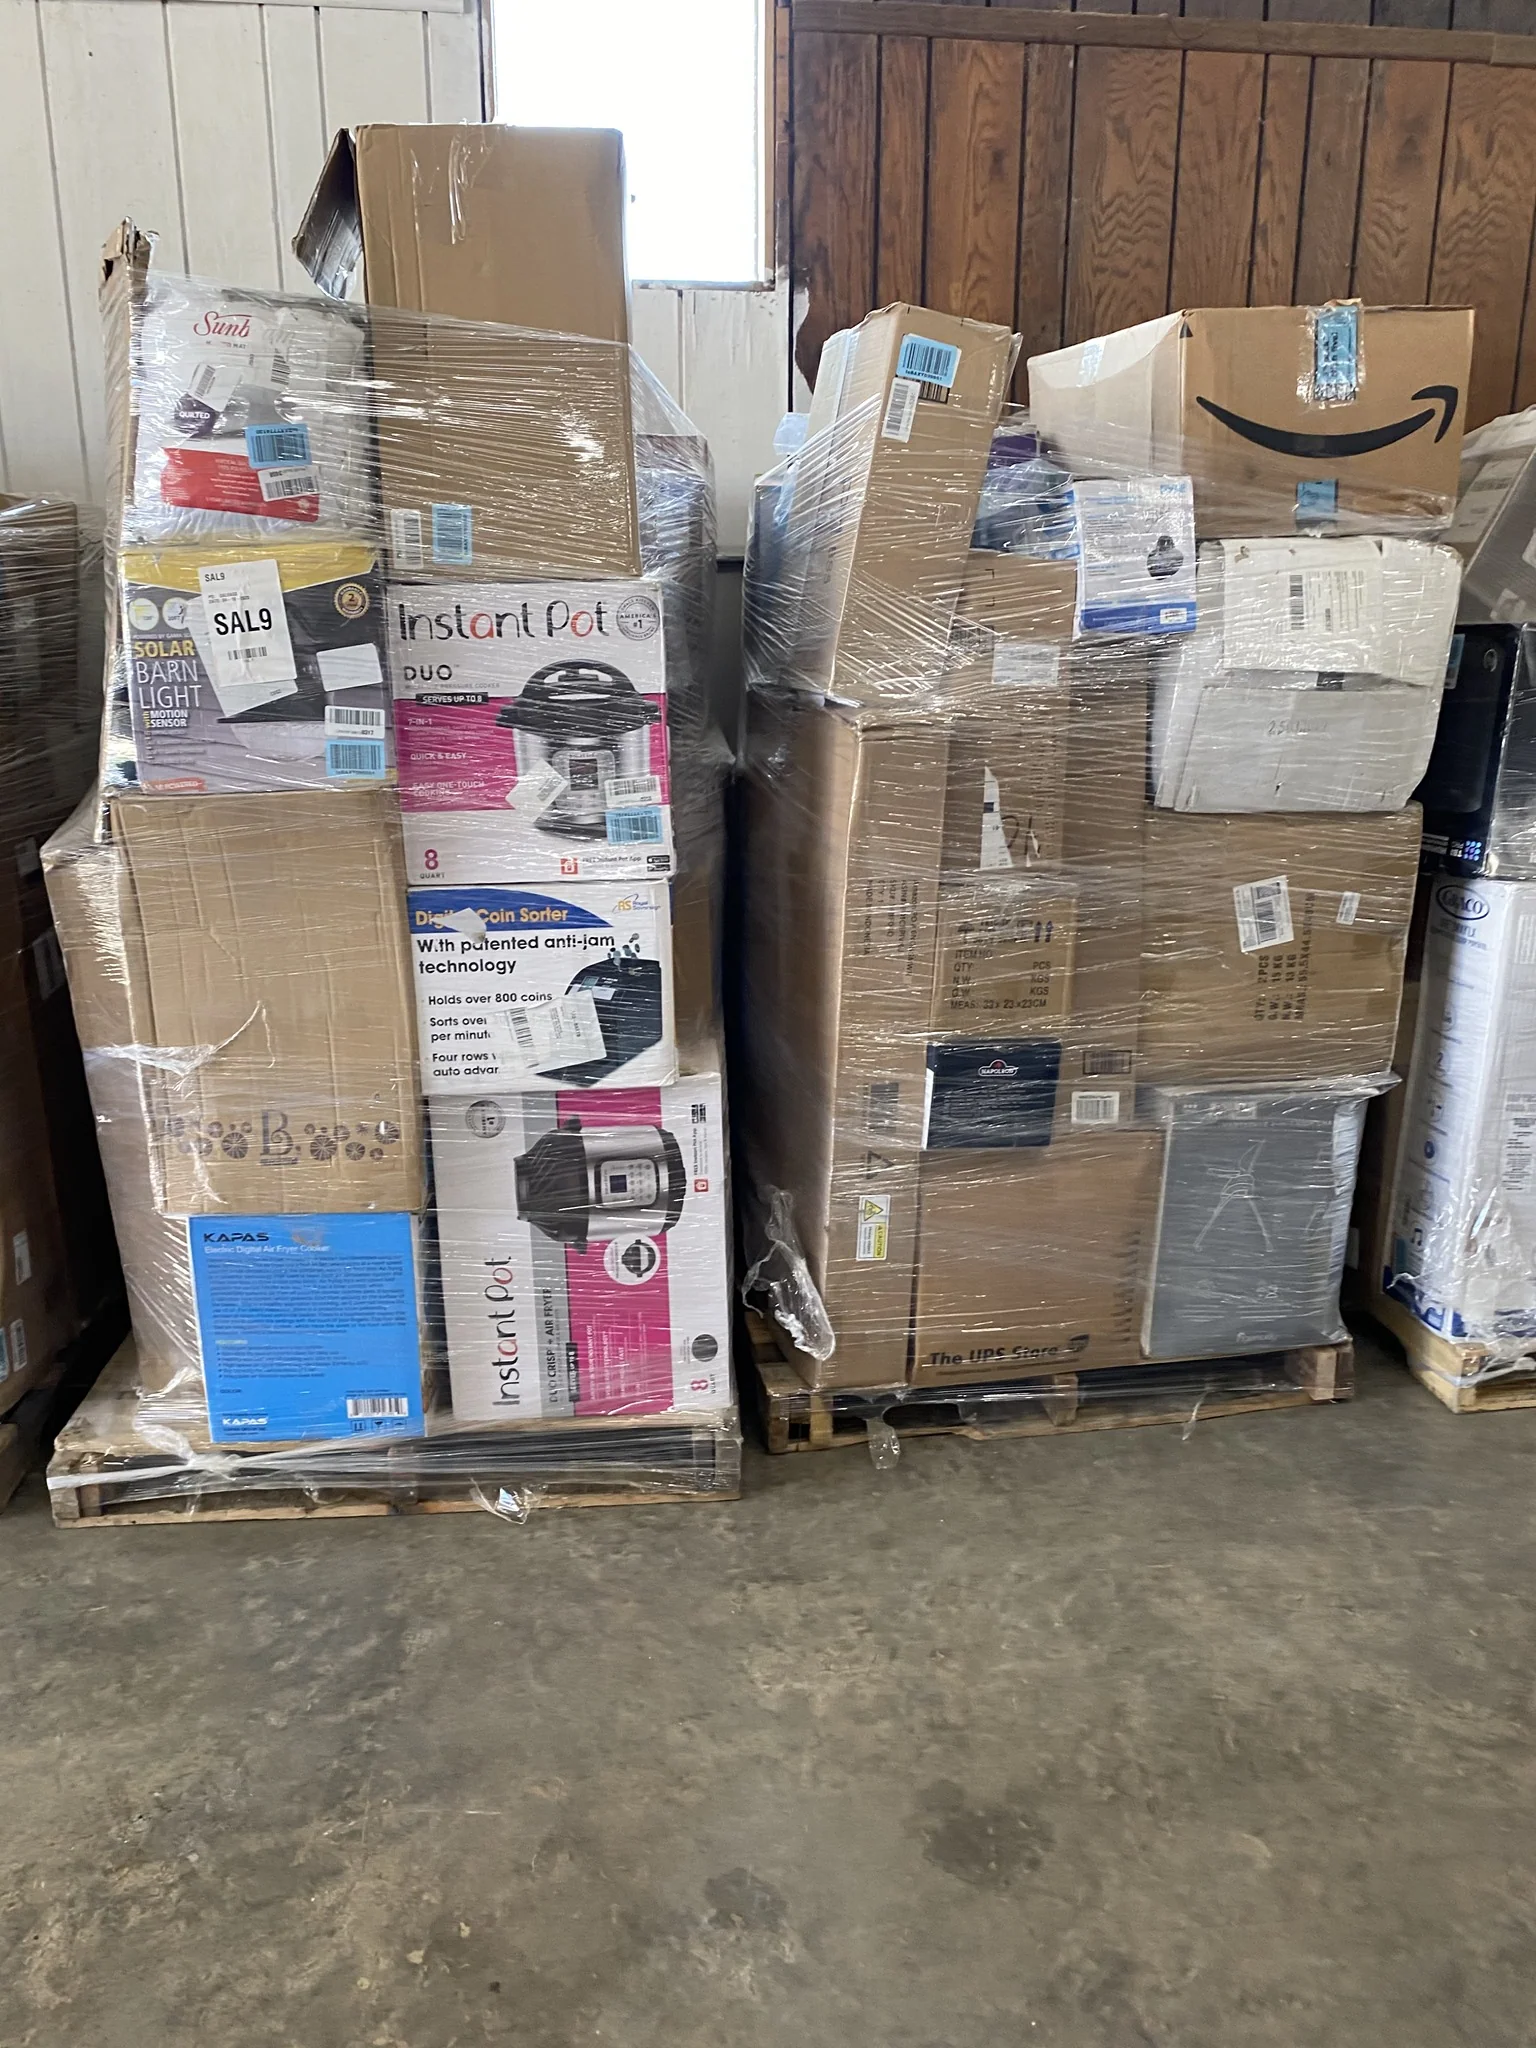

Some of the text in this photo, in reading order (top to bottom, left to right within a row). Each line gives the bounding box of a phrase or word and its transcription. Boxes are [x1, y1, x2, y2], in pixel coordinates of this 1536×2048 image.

[178, 411, 210, 419] QUILTED
[205, 573, 225, 582] SAL9
[214, 608, 272, 636] SAL9
[399, 600, 610, 640] Instant Pot
[134, 640, 195, 657] SOLAR
[135, 660, 199, 685] BARN
[403, 664, 452, 681] DUO
[138, 684, 202, 709] LIGHT
[422, 695, 453, 703] SERVES
[453, 695, 464, 703] UP
[466, 695, 477, 703] TO
[150, 710, 188, 718] MOTION
[151, 718, 187, 728] SENSOR
[445, 752, 467, 760] EASY
[424, 849, 439, 870] 8
[618, 900, 632, 911] RS
[480, 907, 568, 923] Coin Sorter
[417, 934, 616, 953] With patented anti-jam
[419, 958, 517, 975] technology
[1033, 961, 1052, 970] PCS
[1273, 955, 1283, 969] KG
[1286, 954, 1297, 968] KG
[1029, 986, 1049, 995] KGS
[428, 992, 553, 1005] Holds over 800 coins
[430, 1016, 459, 1027] Sorts
[431, 1029, 491, 1044] per minut
[432, 1053, 489, 1063] Four rows
[433, 1067, 461, 1077] auto
[203, 1232, 270, 1243] KAPAS
[263, 1245, 276, 1253] Air
[542, 1288, 554, 1317] FRYER
[544, 1319, 554, 1336] AIR
[487, 1309, 520, 1406] Instant
[930, 1344, 1059, 1366] The UPS Store
[546, 1348, 558, 1378] CRISP
[223, 1417, 267, 1425] KAPAS
